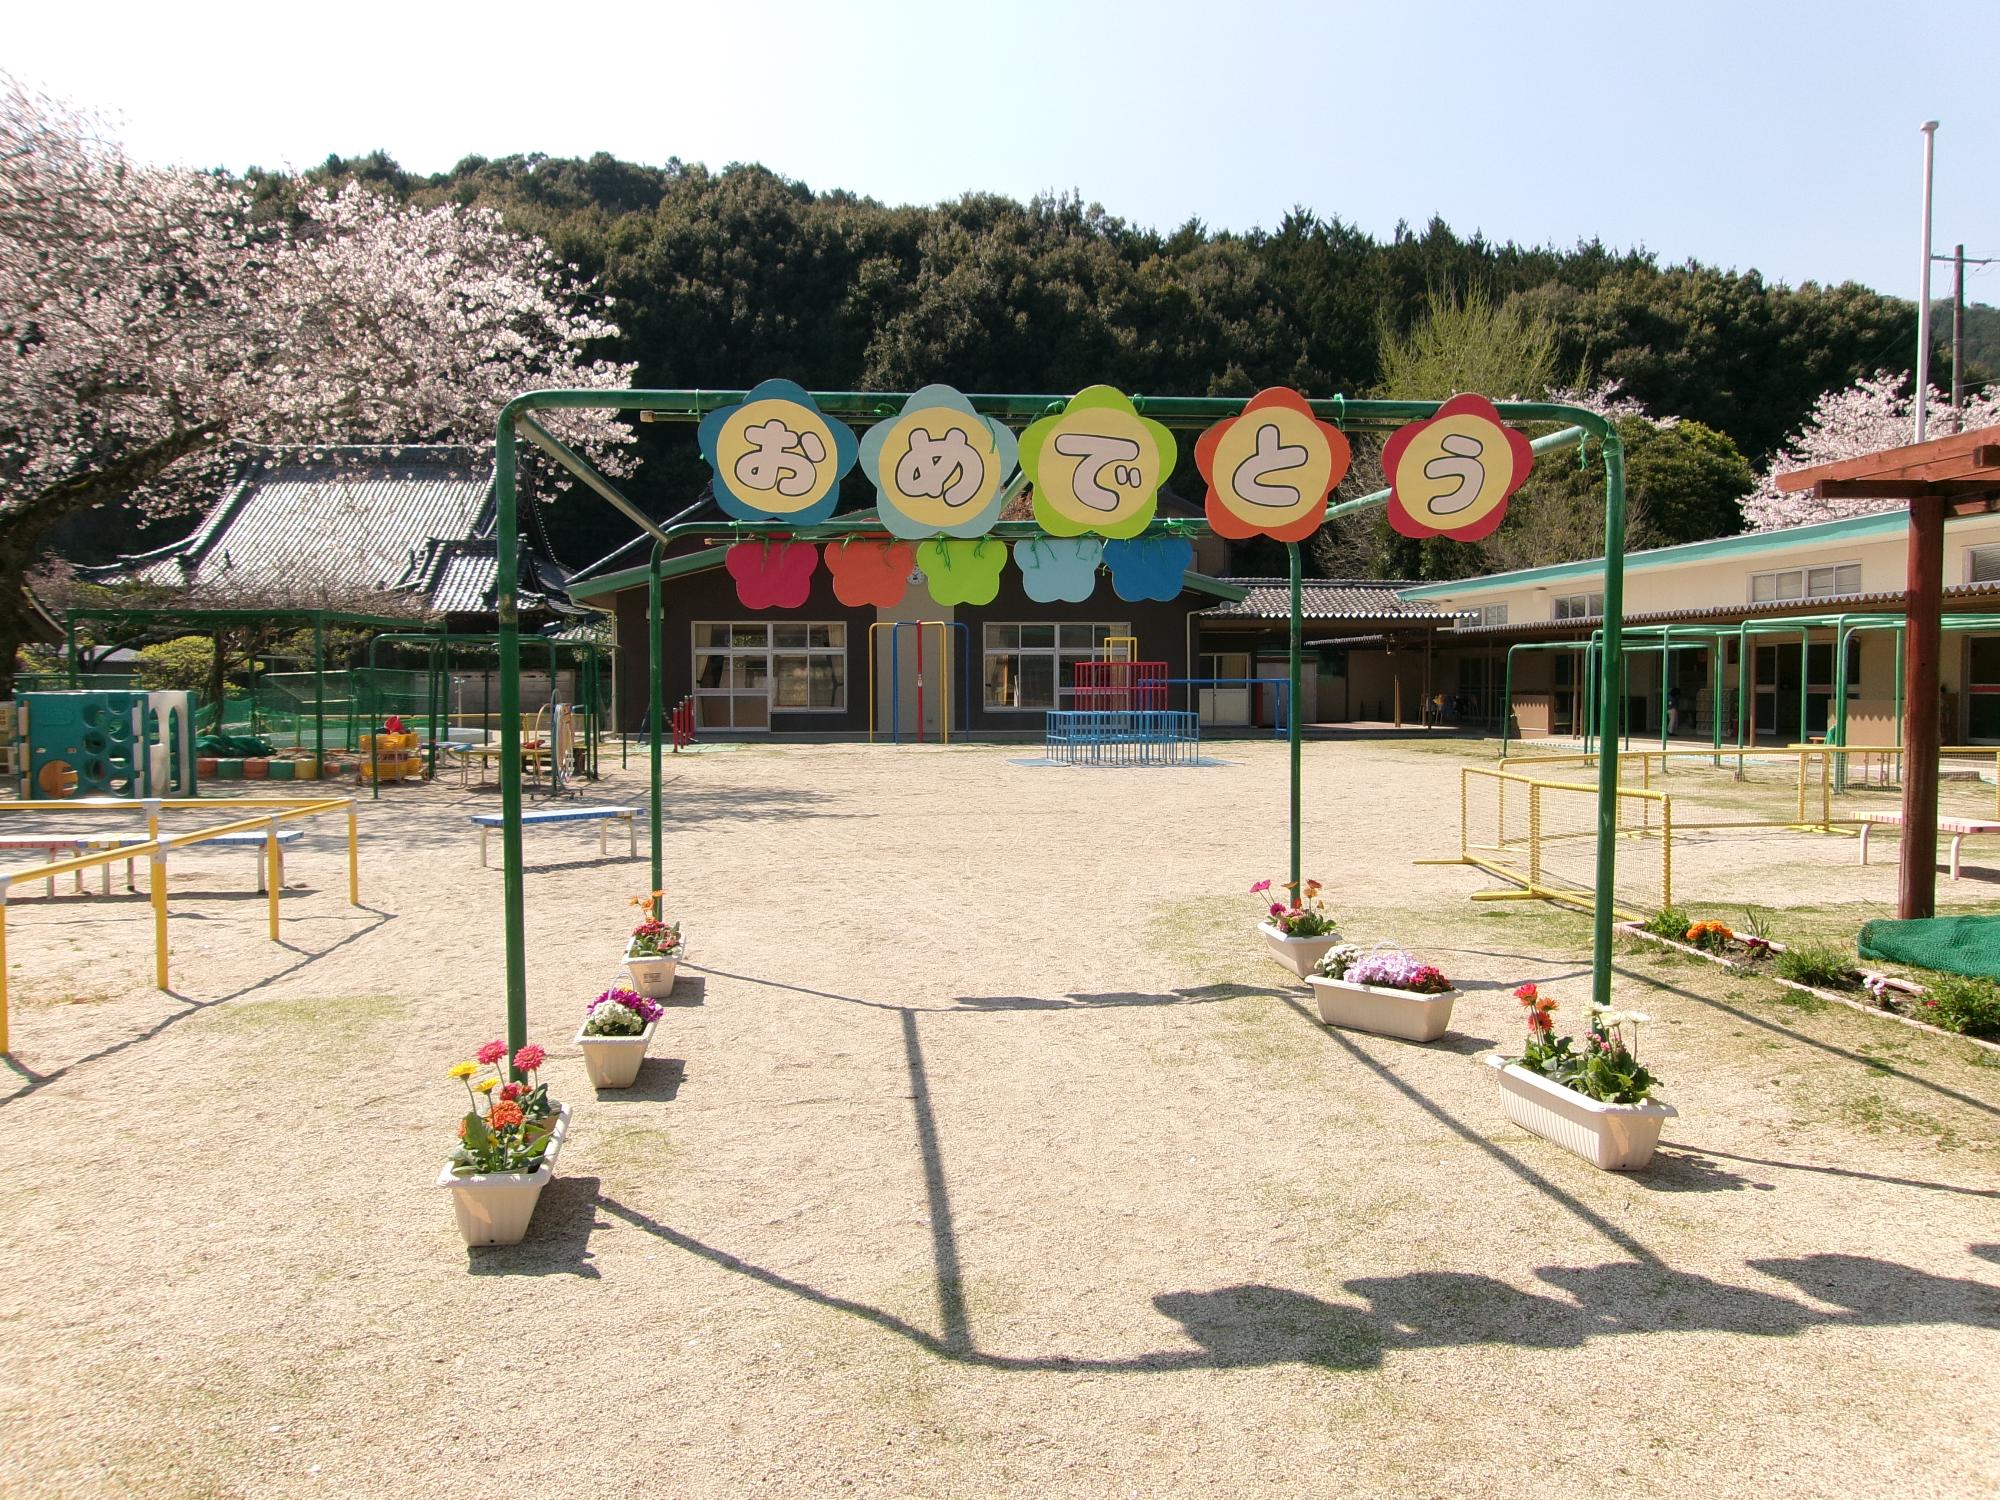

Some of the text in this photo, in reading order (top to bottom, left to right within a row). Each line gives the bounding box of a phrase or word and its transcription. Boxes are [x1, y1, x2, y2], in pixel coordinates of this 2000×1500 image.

[734, 419, 1485, 515] おめでとう
